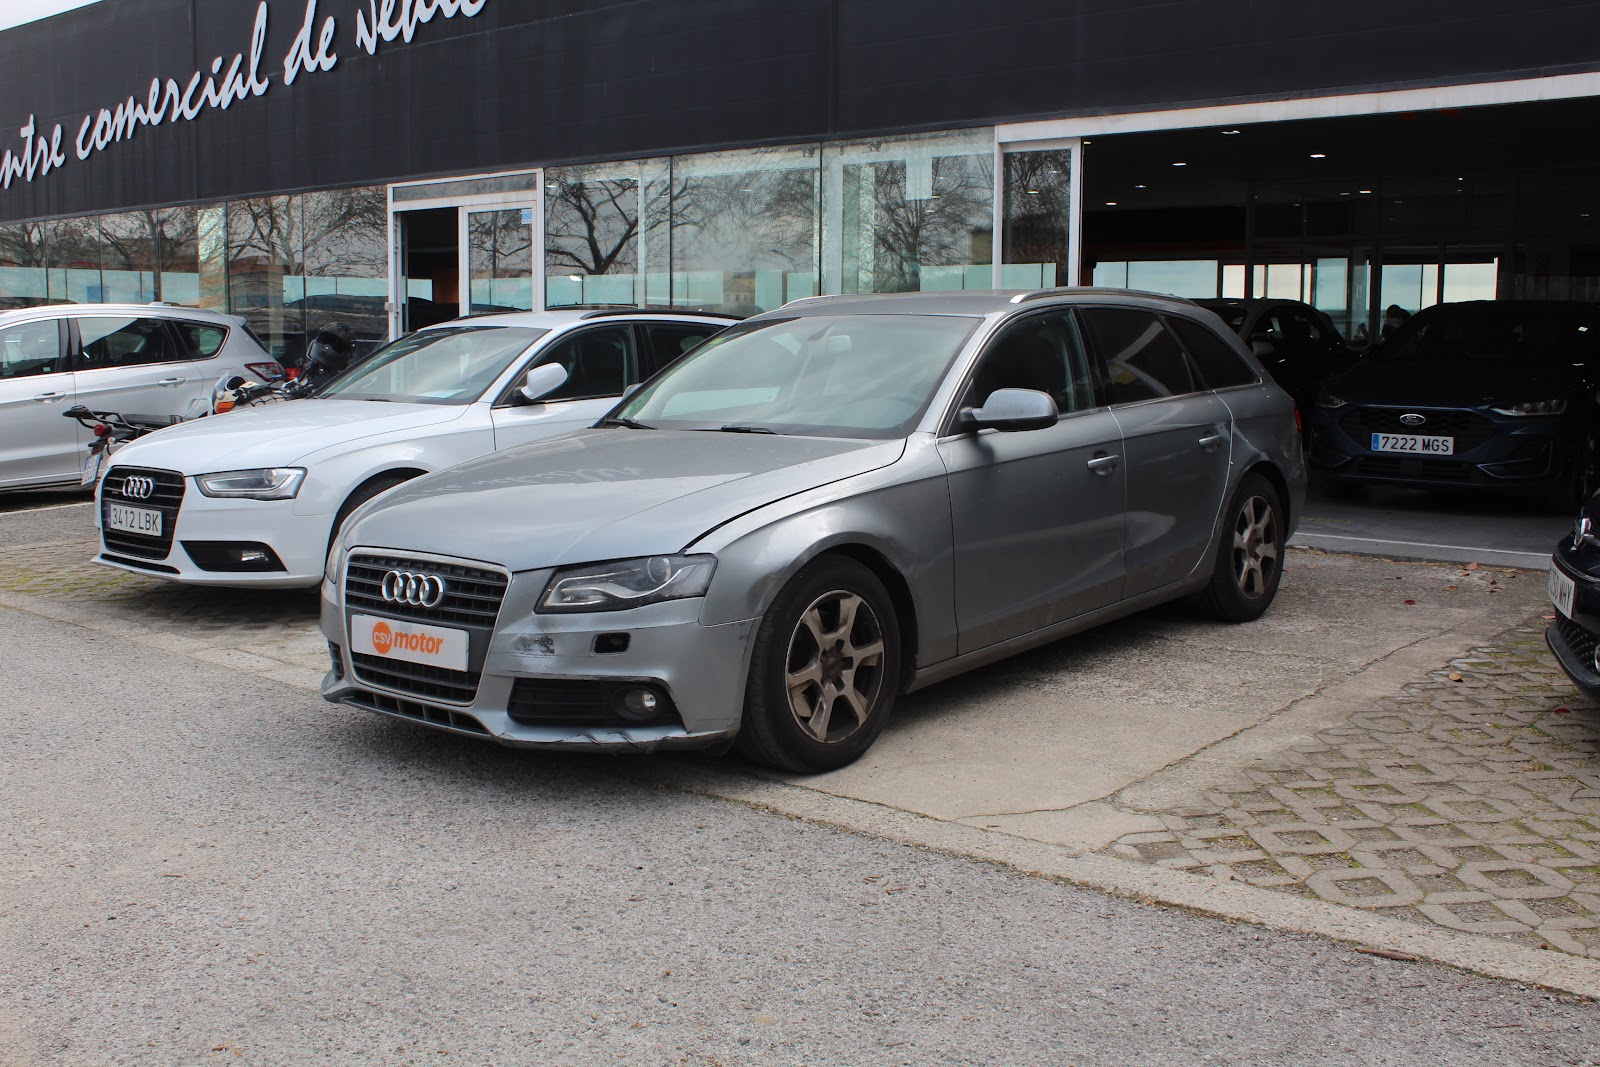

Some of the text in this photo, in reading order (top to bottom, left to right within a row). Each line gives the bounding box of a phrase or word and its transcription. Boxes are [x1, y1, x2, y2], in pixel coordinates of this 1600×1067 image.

[0, 114, 65, 189] ntre
[75, 0, 269, 160] comercial
[284, 0, 337, 86] de
[1382, 436, 1449, 452] 7222 MGS
[112, 507, 159, 532] 3412 LBK
[393, 631, 443, 654] motor
